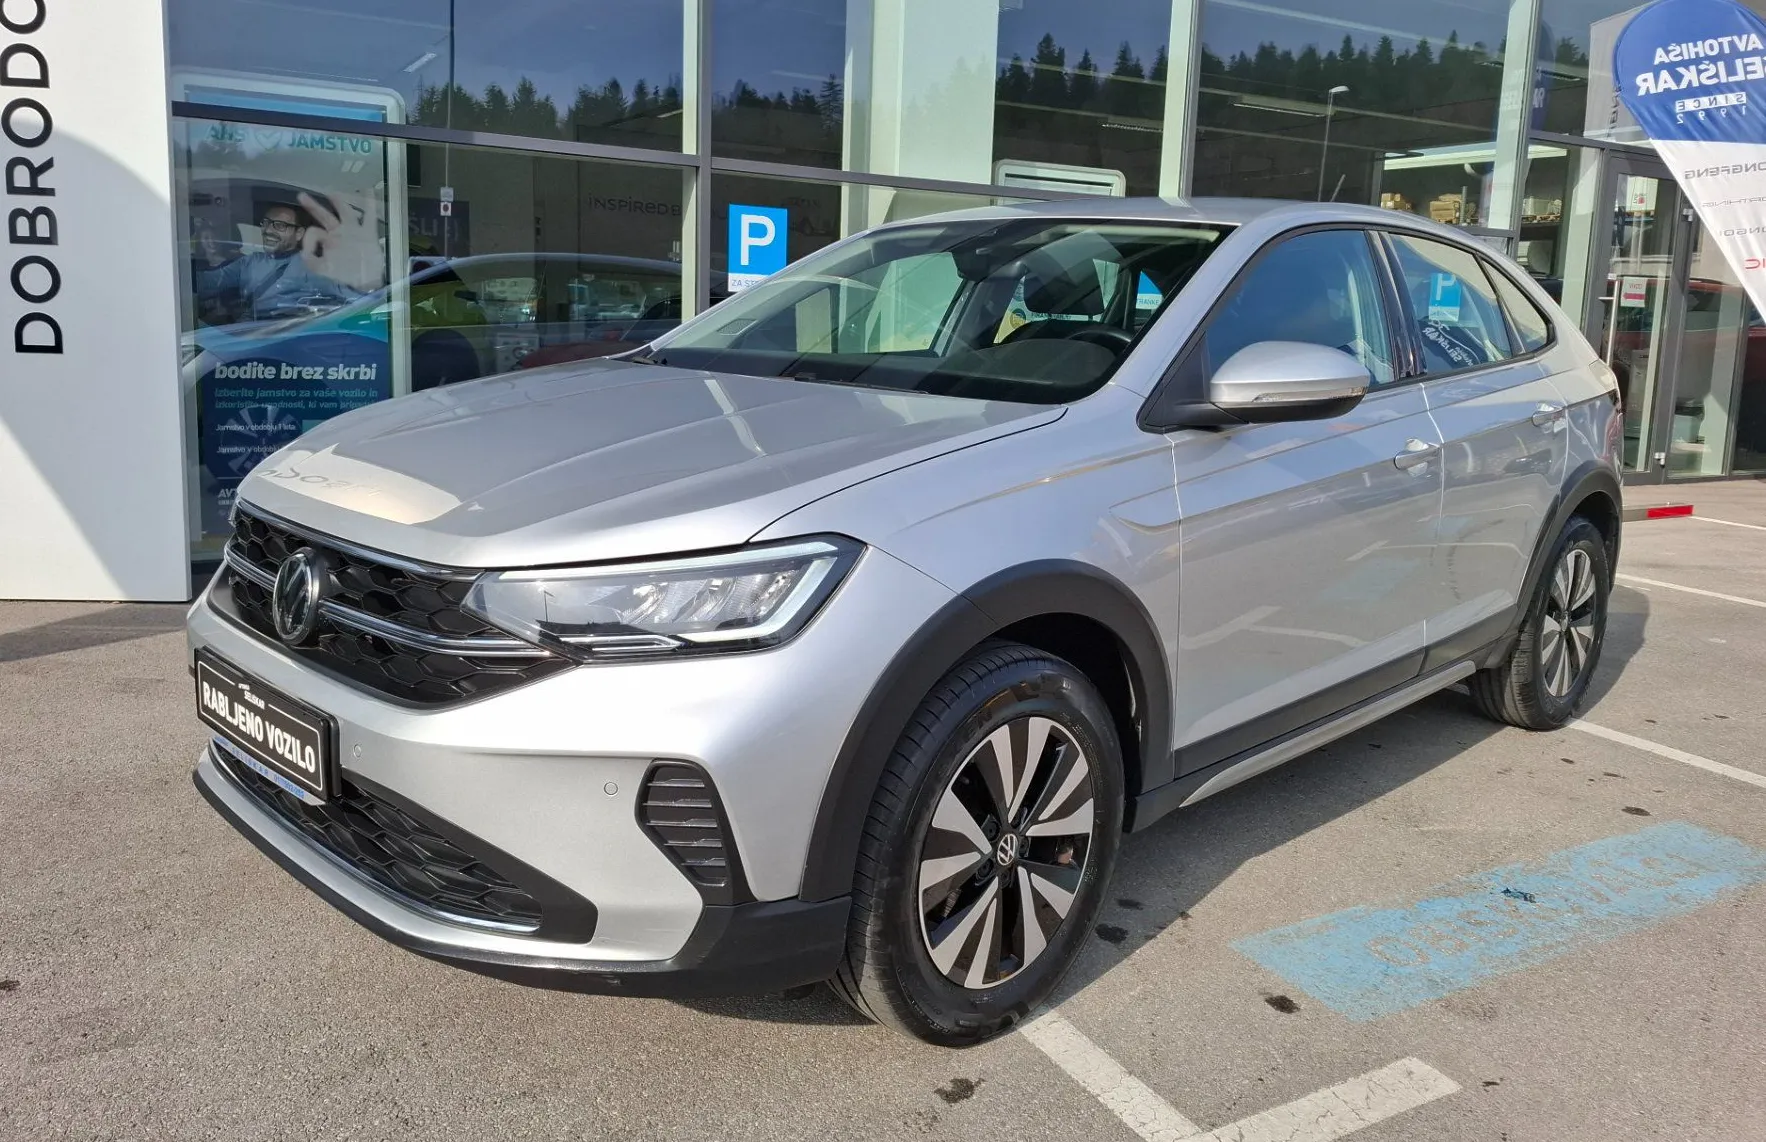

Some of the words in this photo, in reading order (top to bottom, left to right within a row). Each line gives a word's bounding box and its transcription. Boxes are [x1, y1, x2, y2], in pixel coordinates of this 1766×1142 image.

[288, 134, 372, 154] JAMSTVO
[740, 213, 776, 266] P
[214, 362, 277, 379] bodite
[280, 362, 324, 380] brez
[327, 363, 377, 380] skrbi
[256, 388, 297, 400] jamstvo
[298, 390, 311, 398] za
[202, 681, 264, 742] RABLJENO
[264, 720, 316, 773] VOZILO
